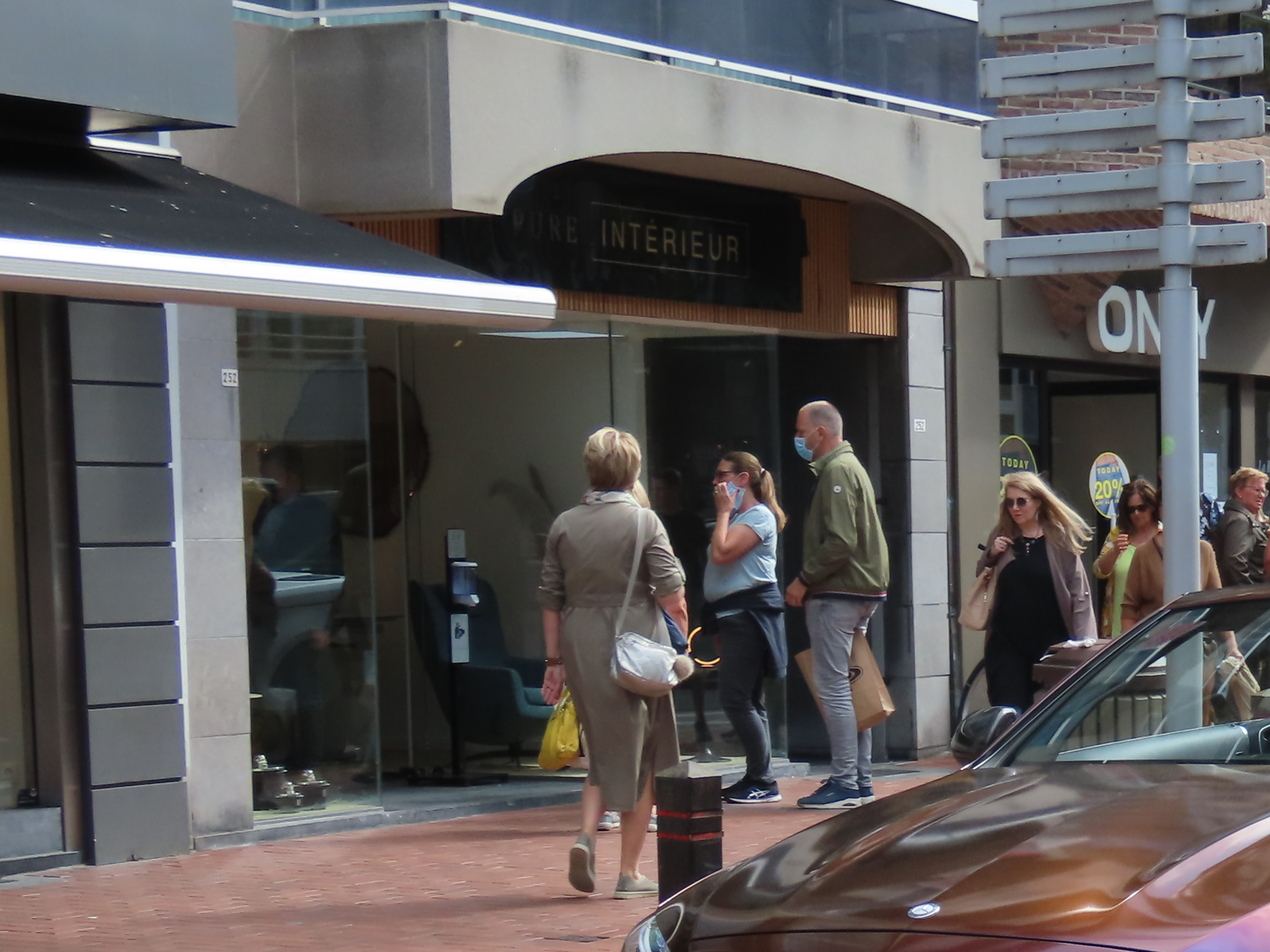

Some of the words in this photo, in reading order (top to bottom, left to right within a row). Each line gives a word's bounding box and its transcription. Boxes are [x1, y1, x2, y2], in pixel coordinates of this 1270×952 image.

[601, 219, 739, 262] INTÉRIEUR
[1097, 284, 1217, 360] ONY
[1001, 456, 1029, 470] TODAY
[1096, 466, 1120, 475] TODAY
[1095, 479, 1124, 500] 20%
